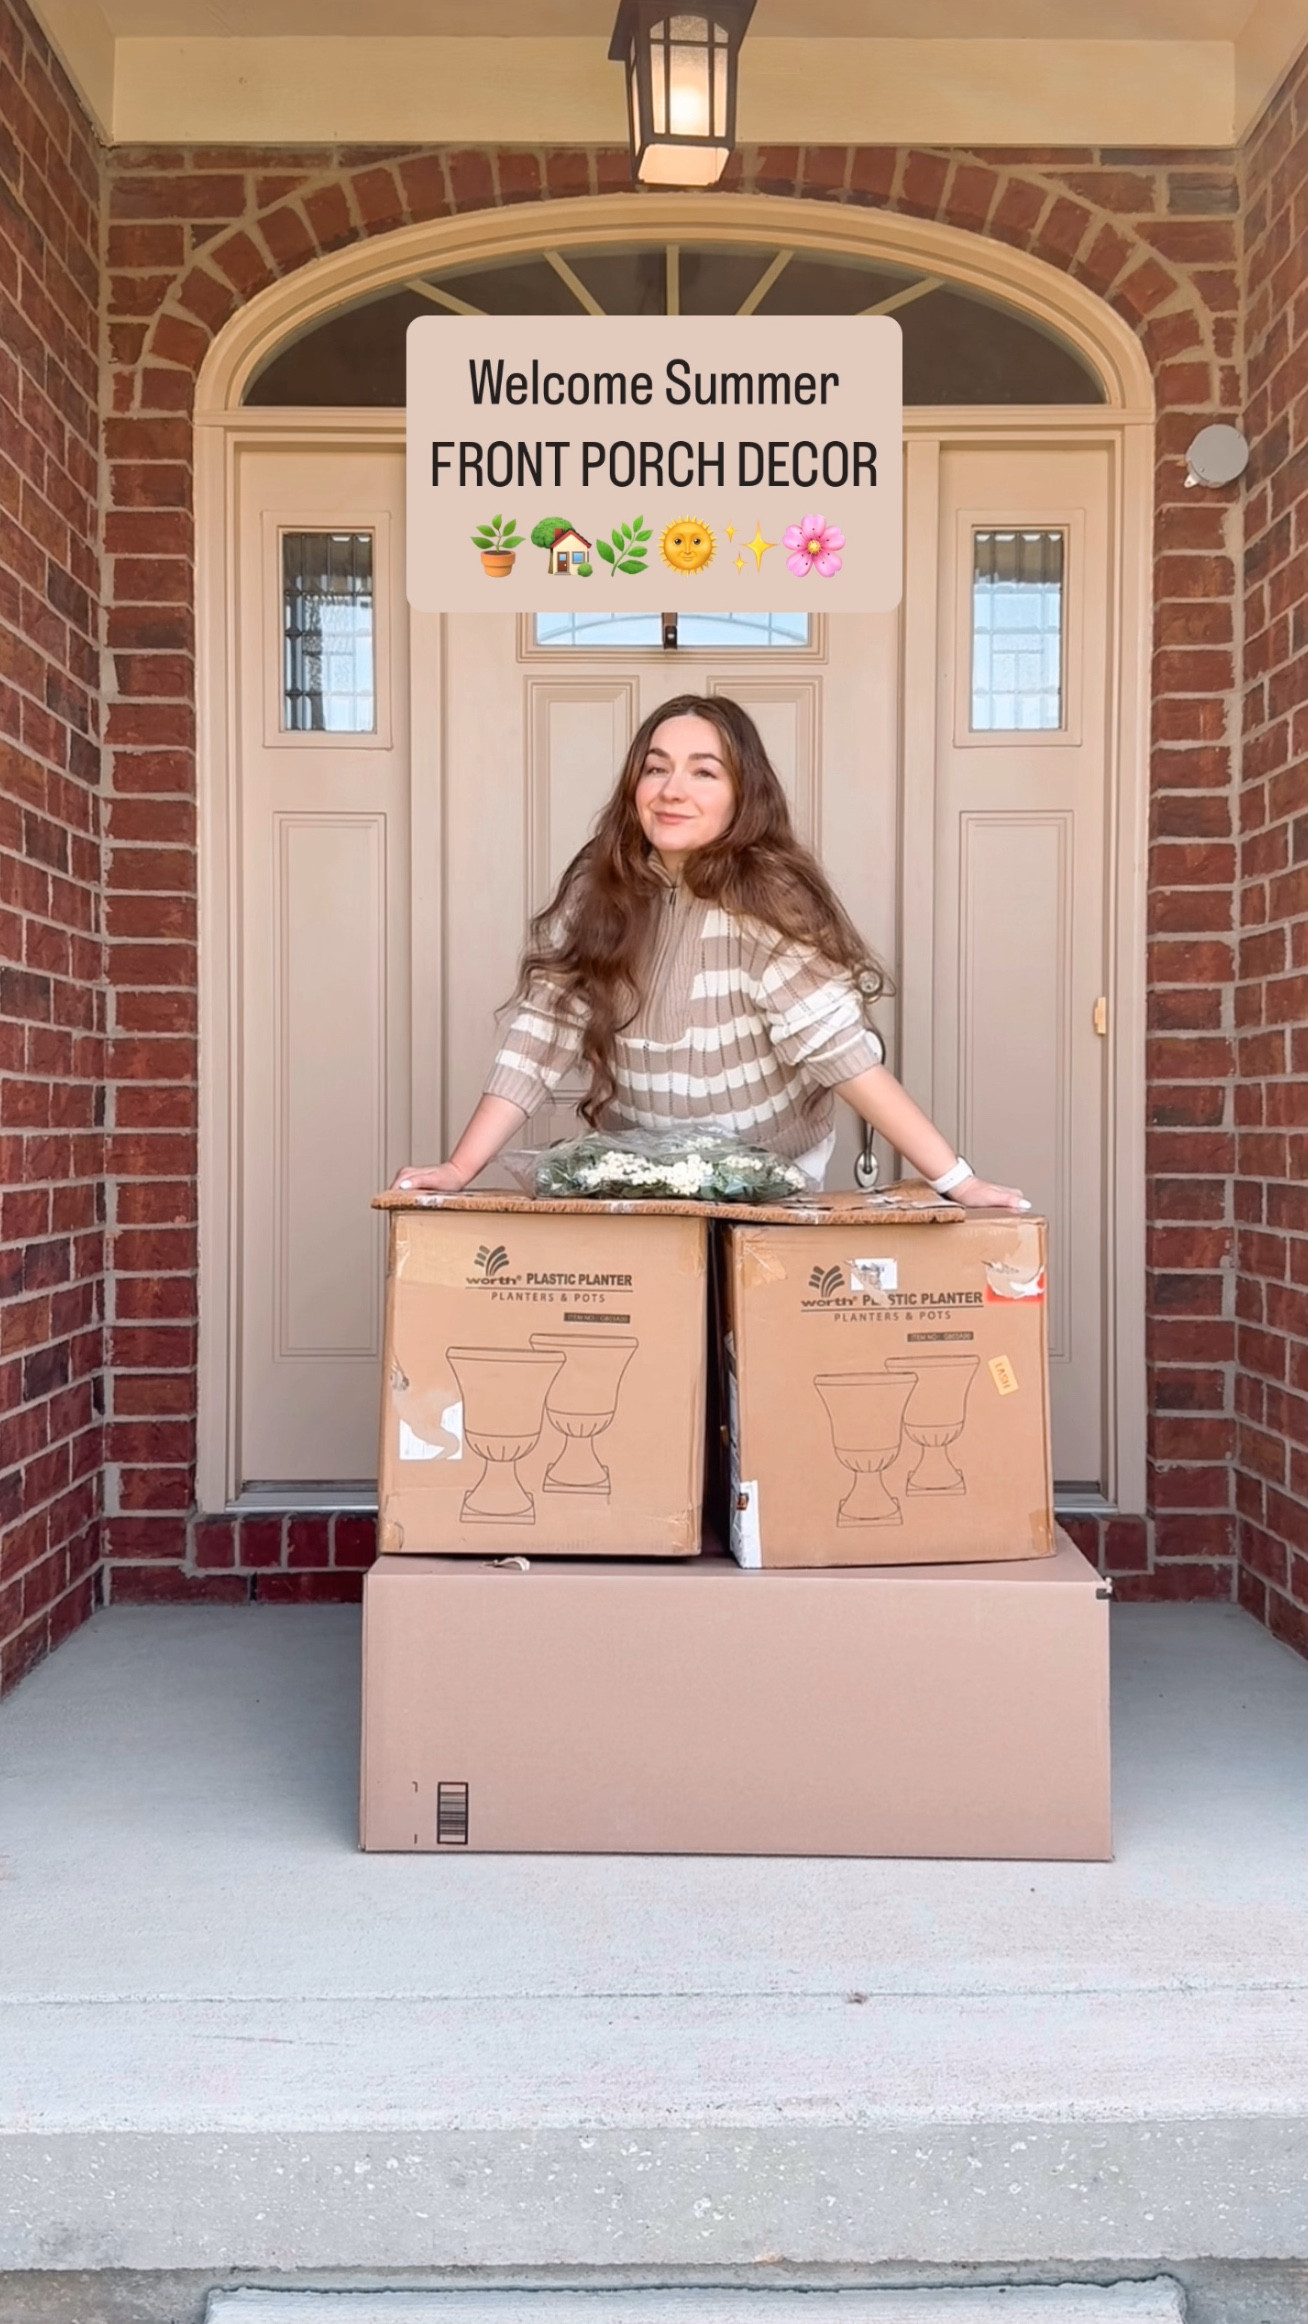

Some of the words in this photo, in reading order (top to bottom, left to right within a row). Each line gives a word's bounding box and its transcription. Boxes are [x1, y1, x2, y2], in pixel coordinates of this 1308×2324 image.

[526, 1273, 576, 1285] PLASTIC
[578, 1274, 632, 1286] PLANTER
[491, 1291, 554, 1302] PLANTERS
[560, 1293, 568, 1302] &
[574, 1293, 605, 1303] POTS
[862, 1293, 917, 1306] PLSTIC
[921, 1292, 983, 1305] PLANTER
[834, 1312, 899, 1322] PLANTERS
[905, 1311, 913, 1320] &
[919, 1310, 952, 1321] POTS
